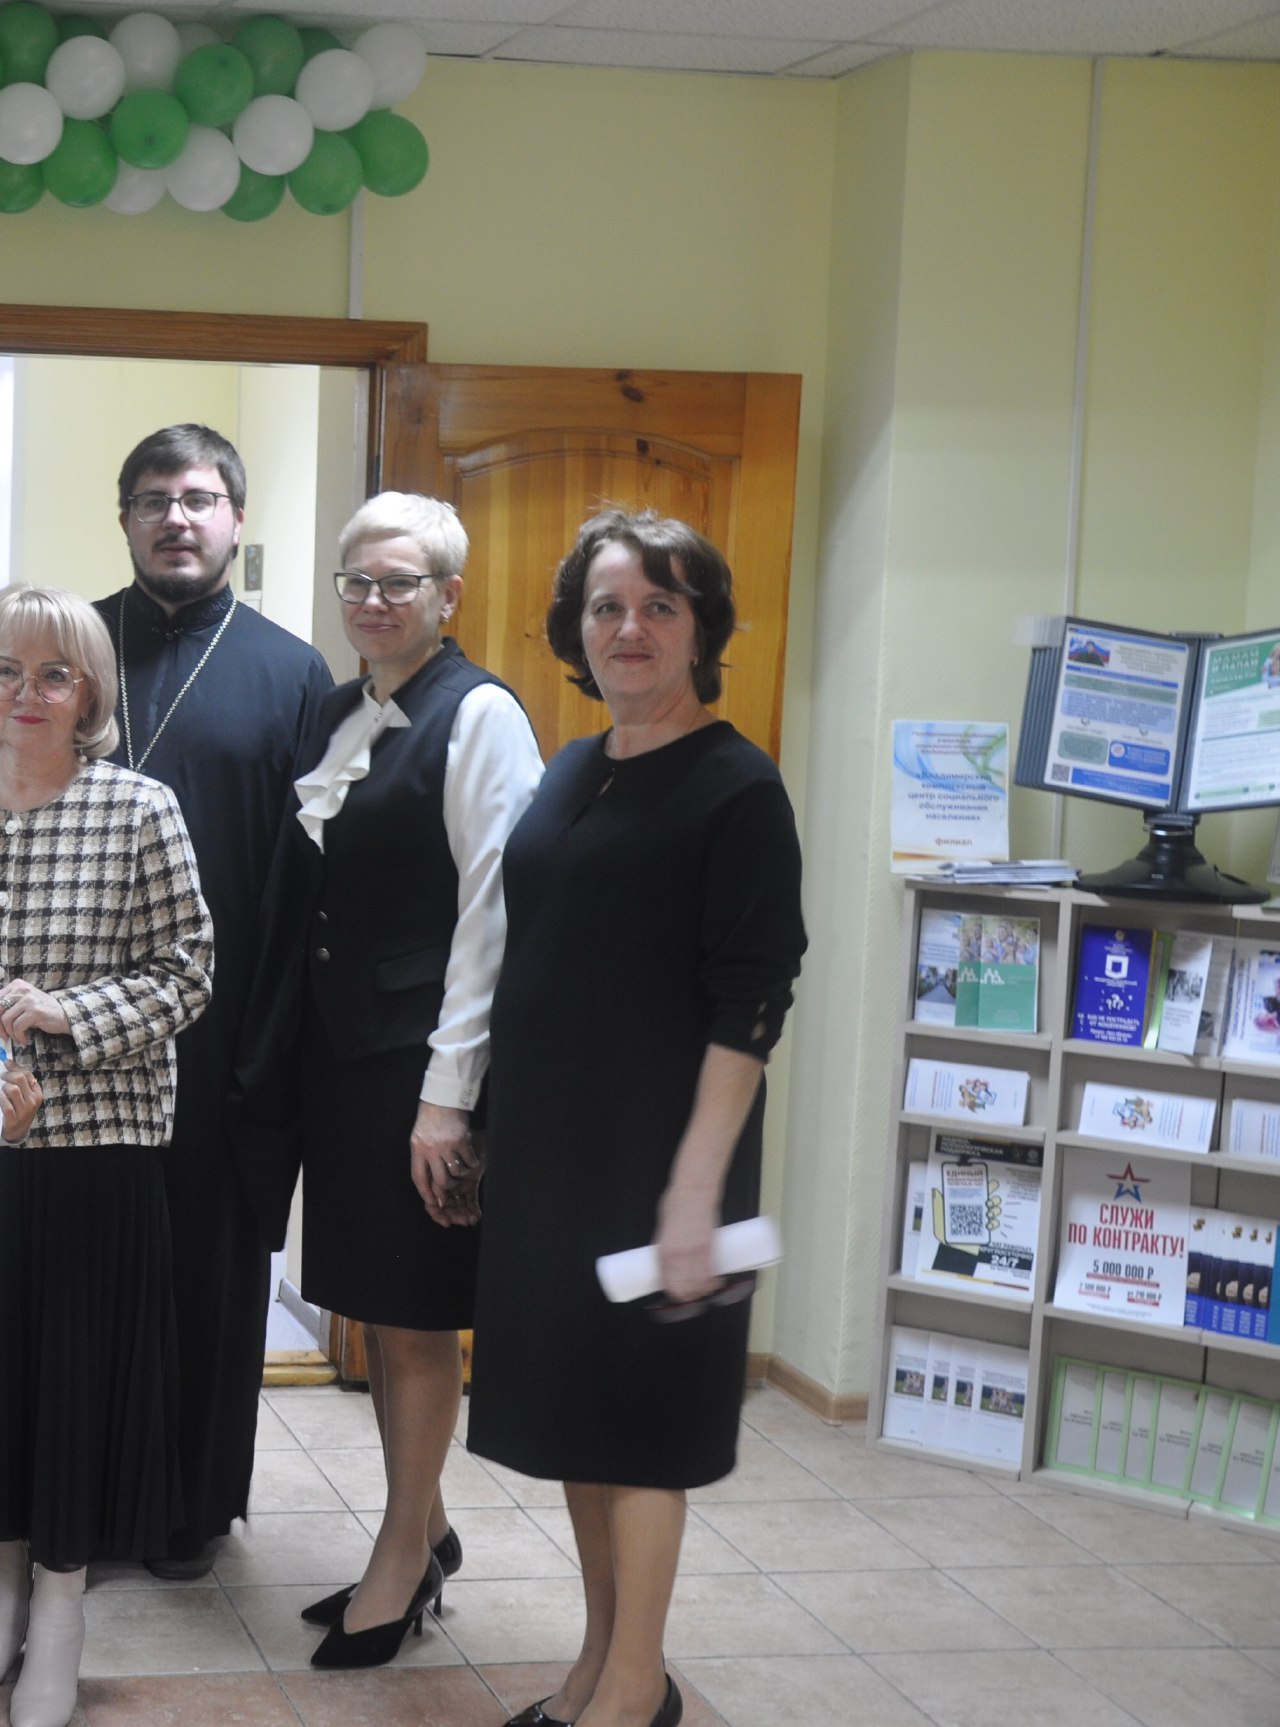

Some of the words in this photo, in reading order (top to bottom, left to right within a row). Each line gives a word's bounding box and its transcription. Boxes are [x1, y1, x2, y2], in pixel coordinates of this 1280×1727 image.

[934, 837, 973, 847] филиал
[1099, 1203, 1155, 1230] СЛУЖИ
[1067, 1222, 1088, 1245] ПО
[1092, 1226, 1185, 1259] КОНТРАКТУ!
[990, 1255, 1019, 1267] 24/7
[1092, 1259, 1100, 1273] 5
[1102, 1260, 1122, 1276] 000
[1124, 1264, 1144, 1279] 000
